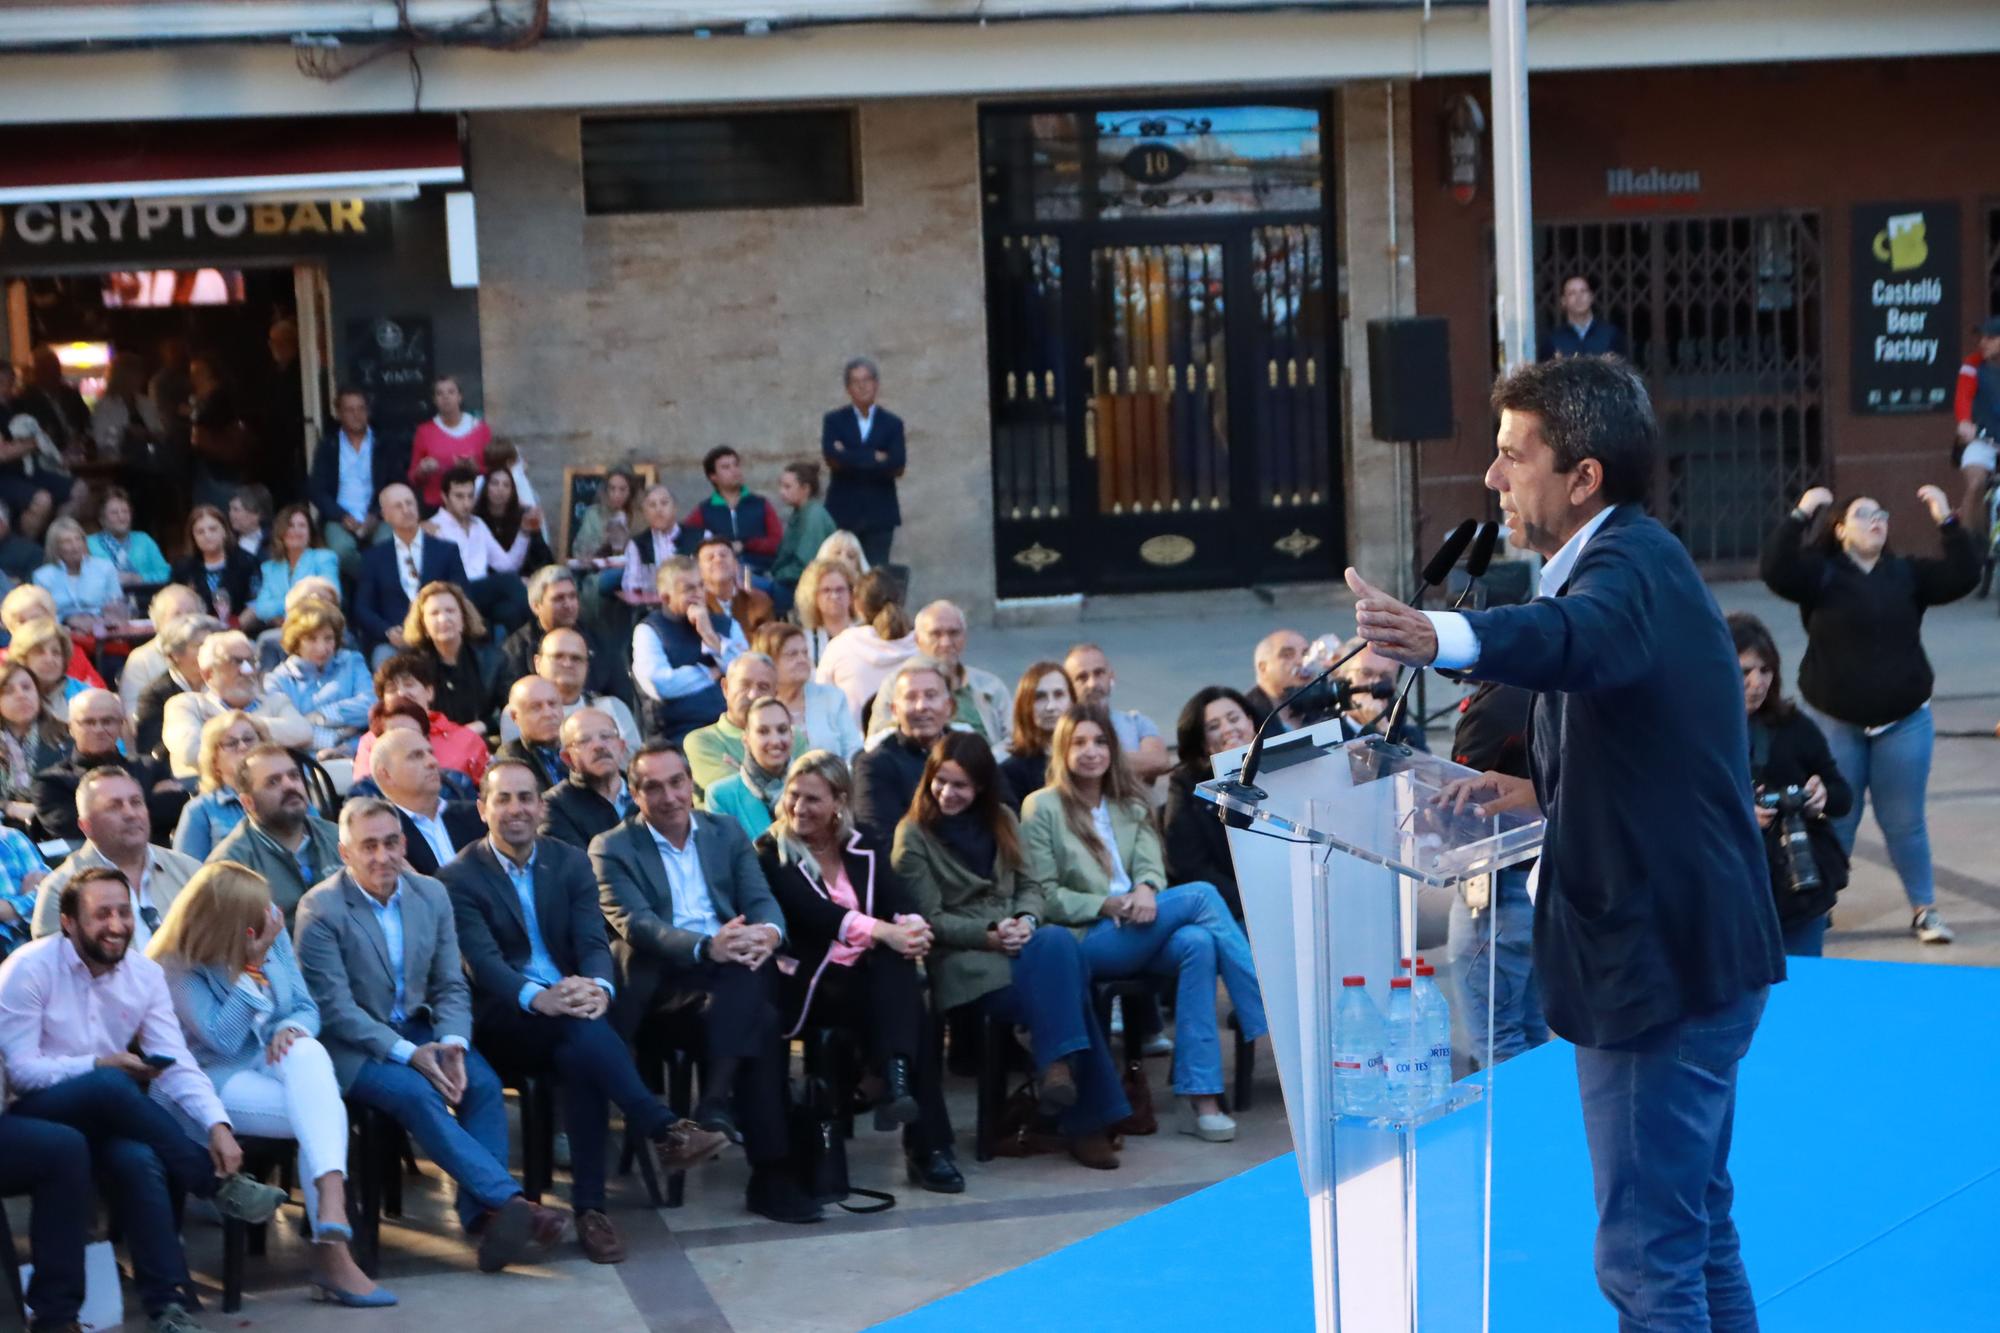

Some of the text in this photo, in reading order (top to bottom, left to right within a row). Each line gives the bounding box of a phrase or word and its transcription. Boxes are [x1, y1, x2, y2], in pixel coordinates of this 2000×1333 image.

[1145, 152, 1168, 176] 10
[1872, 277, 1941, 306] Castelló
[1887, 308, 1926, 333] Beer
[1875, 336, 1938, 364] Factory
